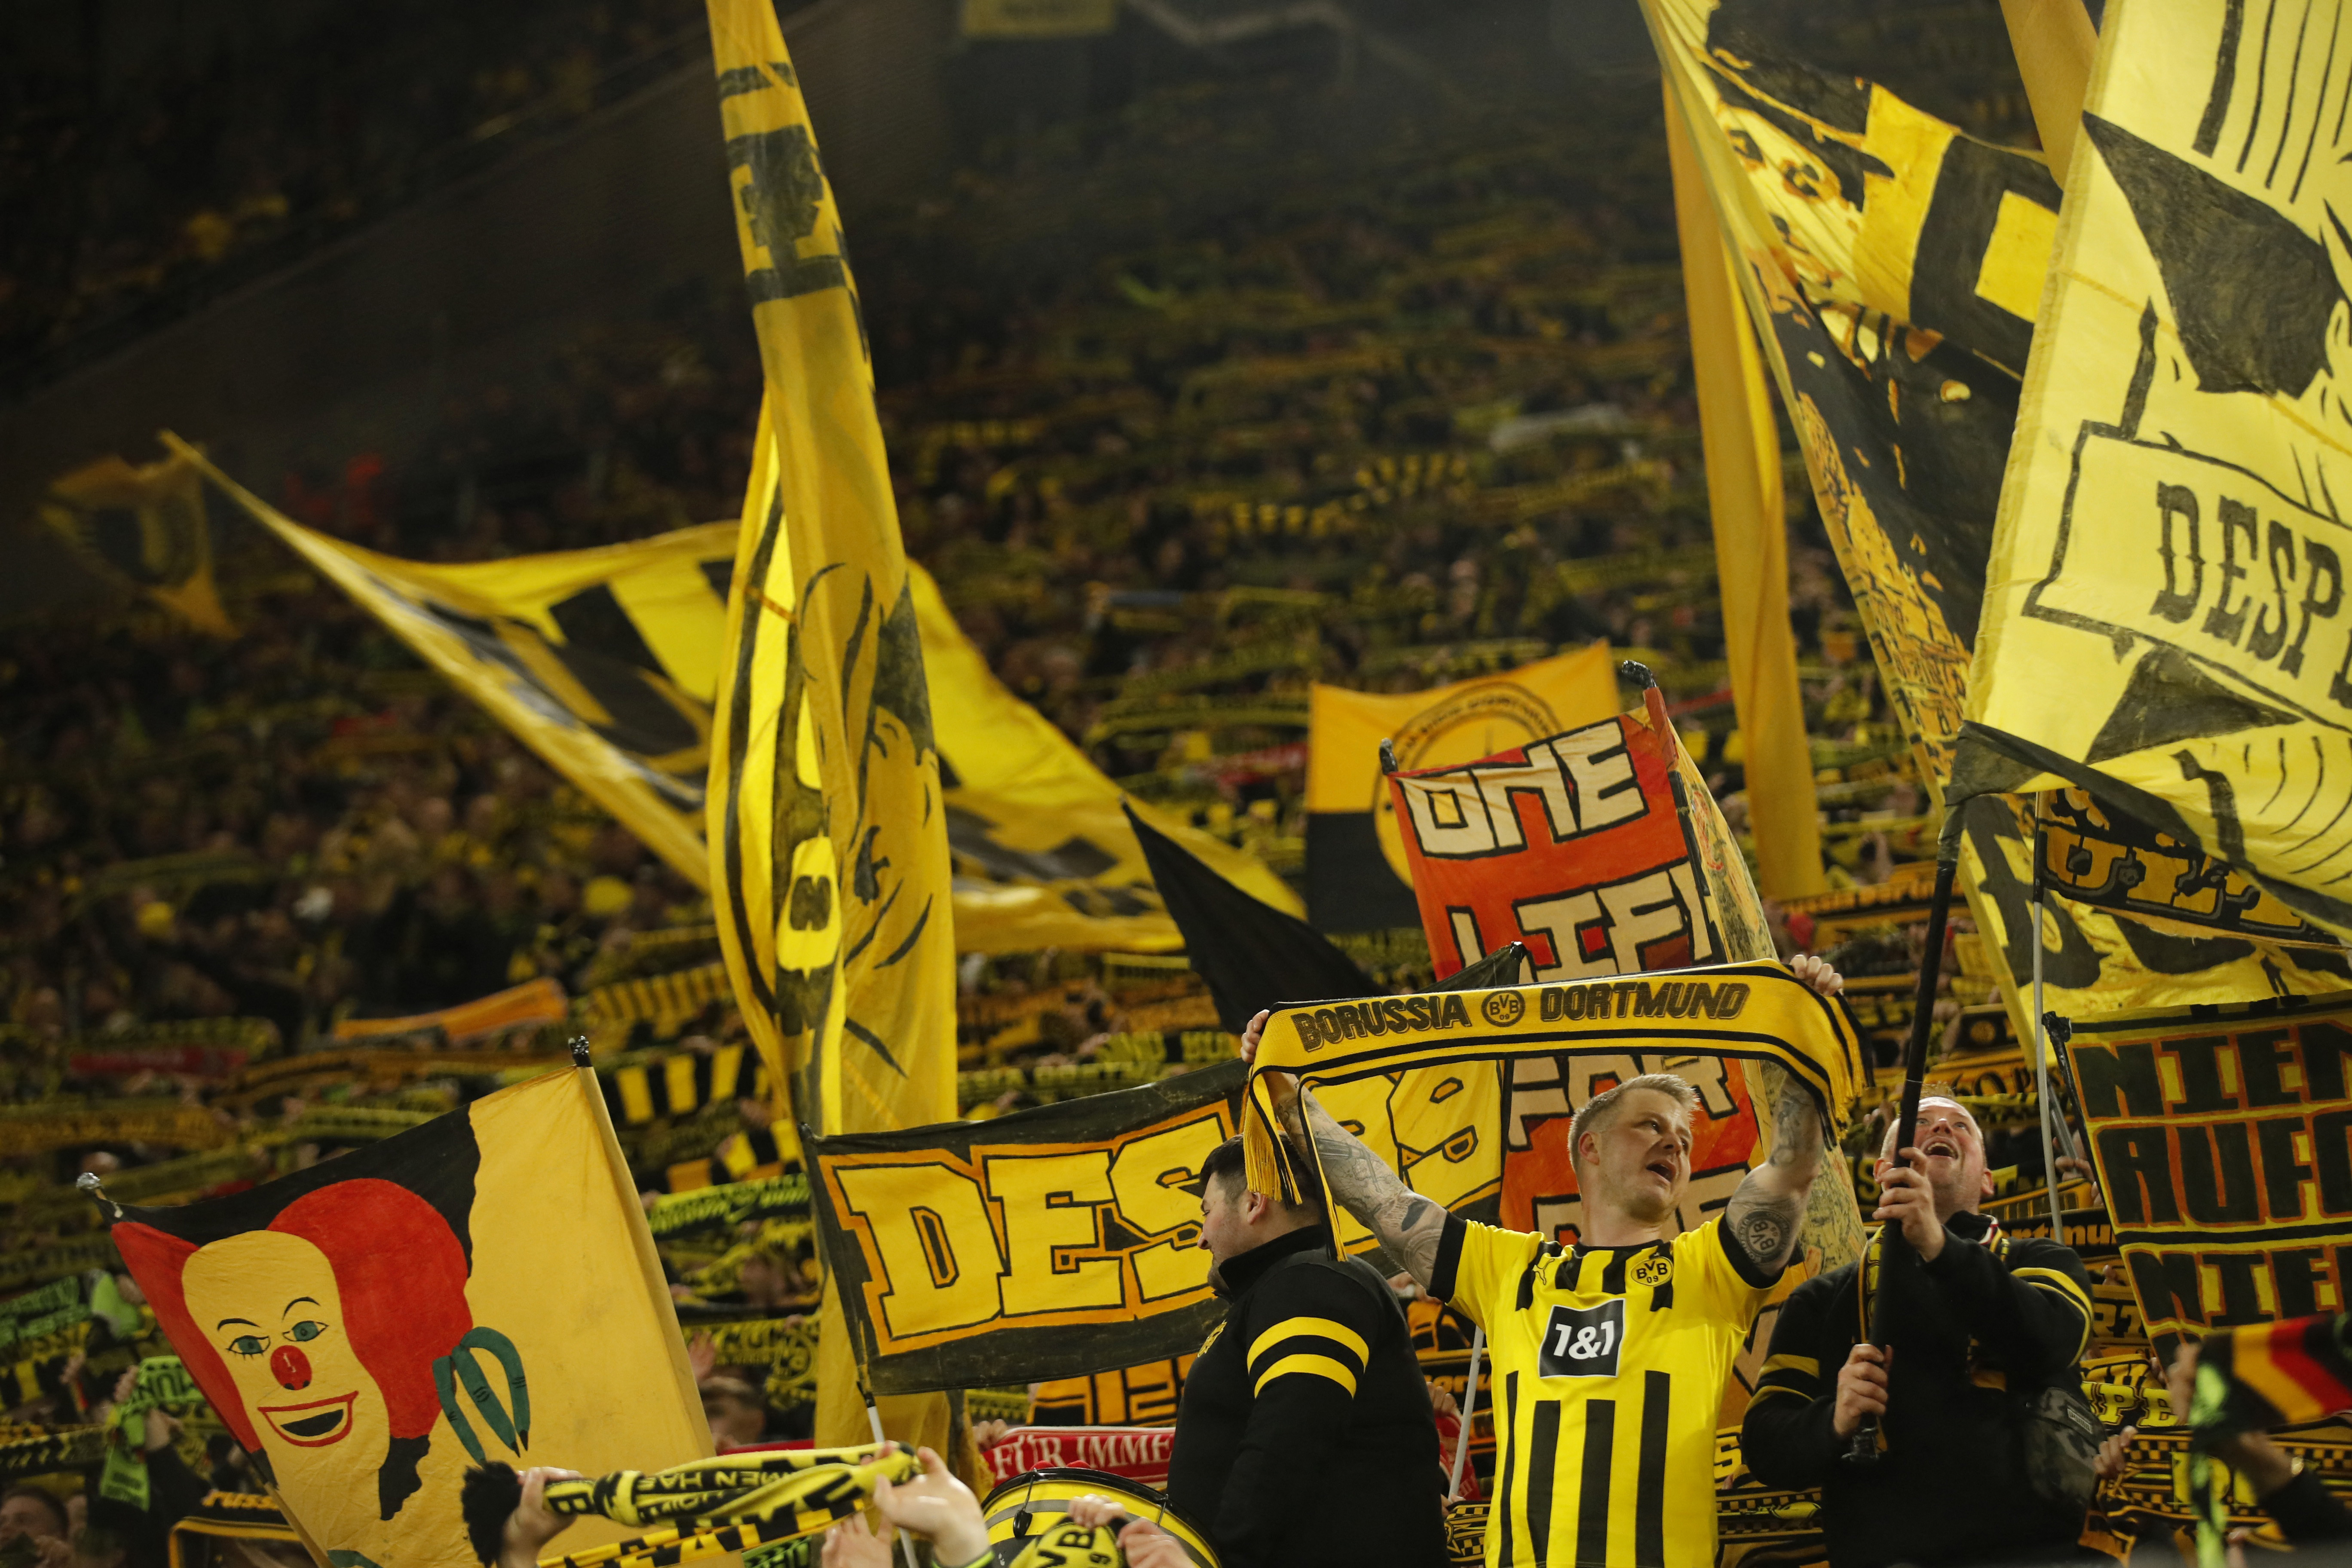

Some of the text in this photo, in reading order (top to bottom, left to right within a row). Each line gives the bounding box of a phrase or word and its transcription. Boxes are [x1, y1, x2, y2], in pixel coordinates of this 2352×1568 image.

[1398, 715, 1650, 858] ONE
[1291, 982, 1750, 1052] BORUSSIA BVB DORTMUND
[1636, 1260, 1668, 1279] BVB
[2128, 1245, 2352, 1326] NIE
[1553, 1320, 1614, 1360] 1&1
[992, 1434, 1066, 1480] FÜR
